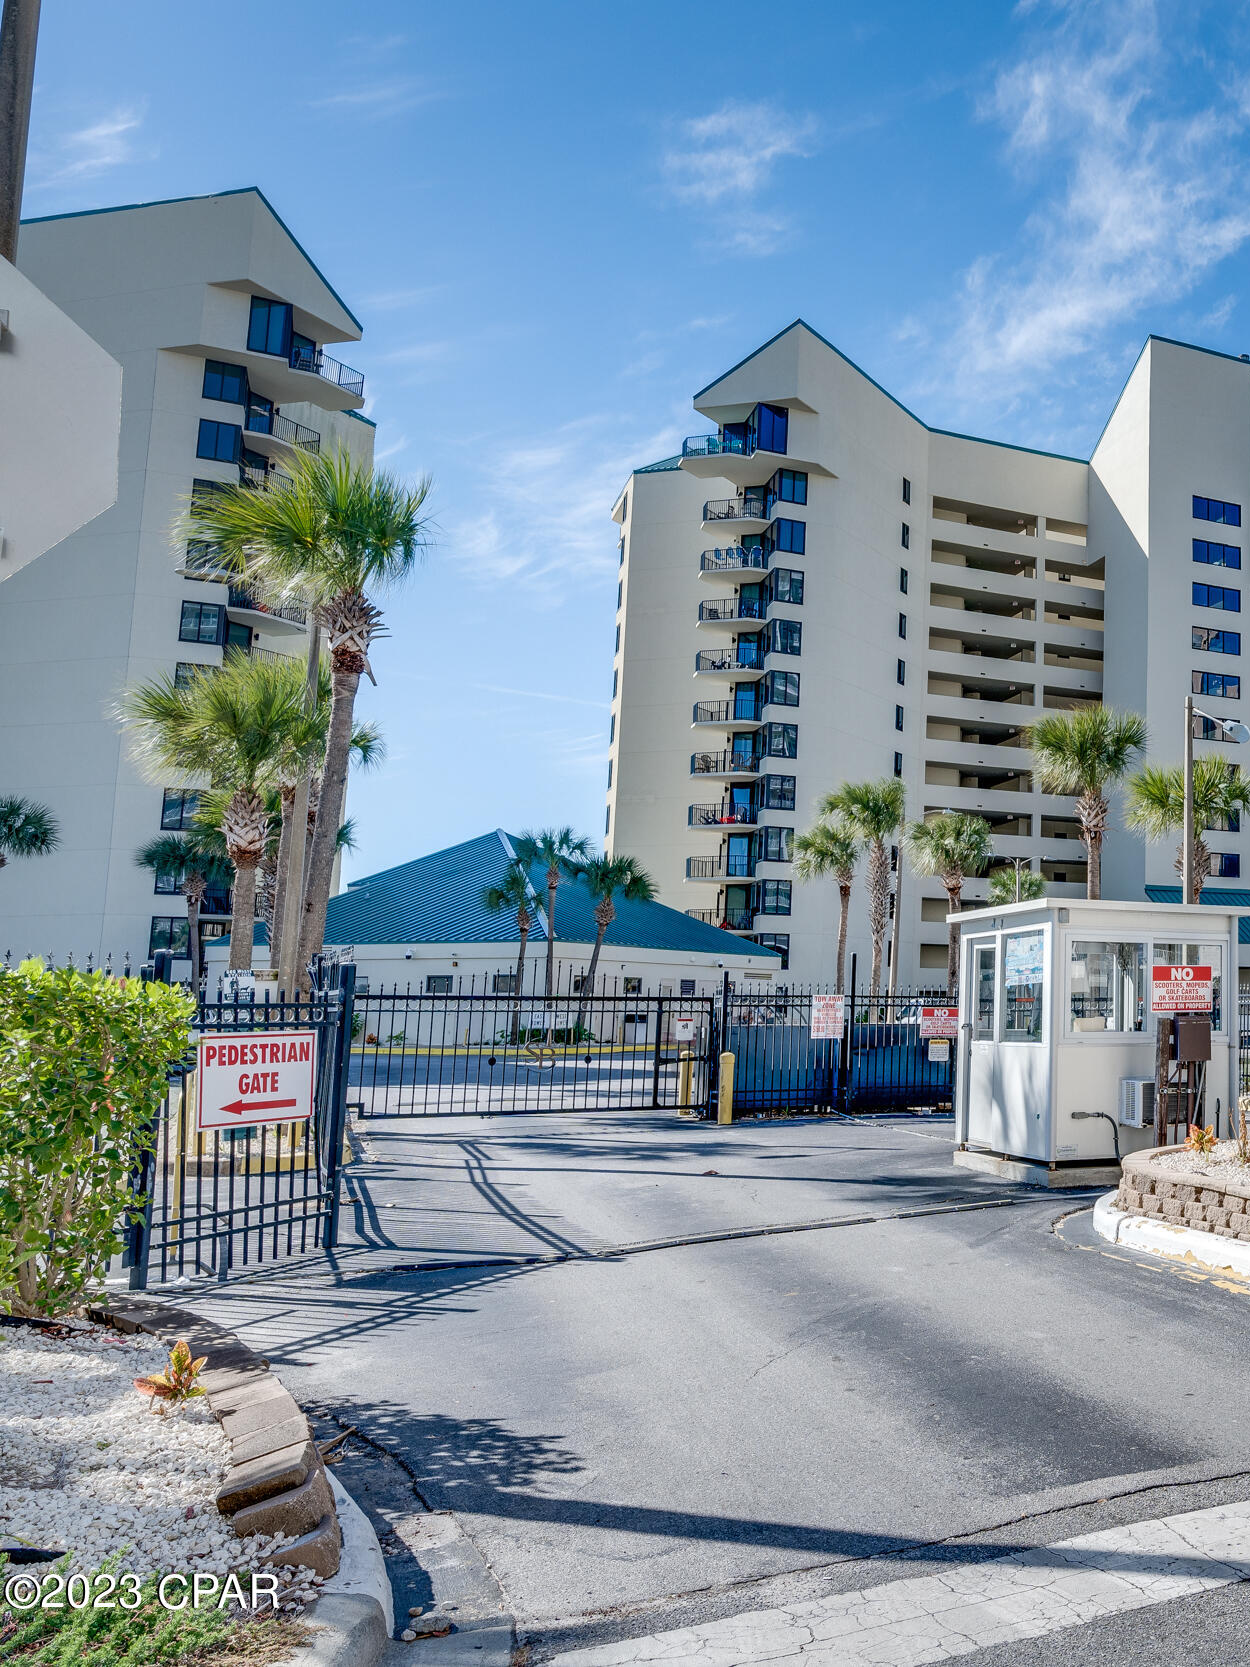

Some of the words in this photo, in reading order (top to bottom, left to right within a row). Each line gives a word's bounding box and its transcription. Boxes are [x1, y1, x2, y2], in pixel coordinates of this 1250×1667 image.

[1170, 967, 1194, 981] NO
[933, 1009, 949, 1017] NO
[205, 1041, 310, 1067] PEDESTRIAN
[238, 1072, 279, 1095] GATE
